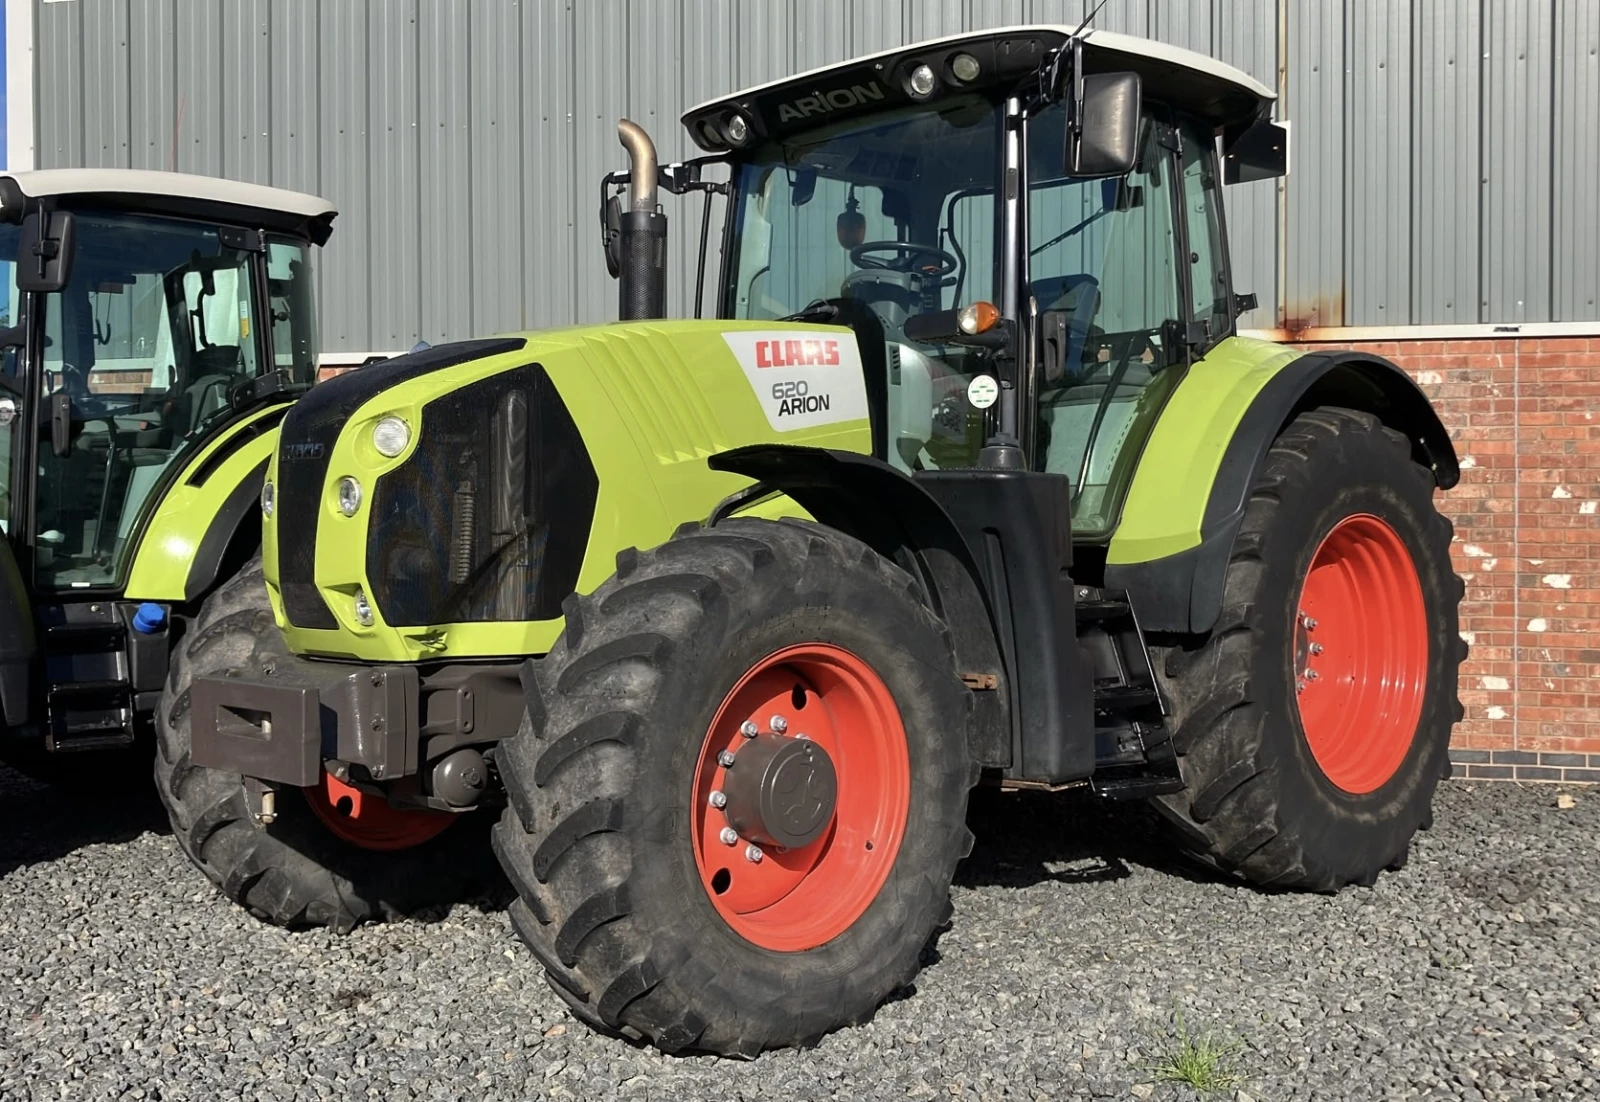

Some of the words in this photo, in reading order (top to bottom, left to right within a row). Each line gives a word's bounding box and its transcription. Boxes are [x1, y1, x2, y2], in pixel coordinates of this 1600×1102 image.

[778, 81, 885, 122] ARION
[755, 340, 840, 368] CLAAS
[772, 380, 808, 400] 620
[778, 394, 830, 417] ARION
